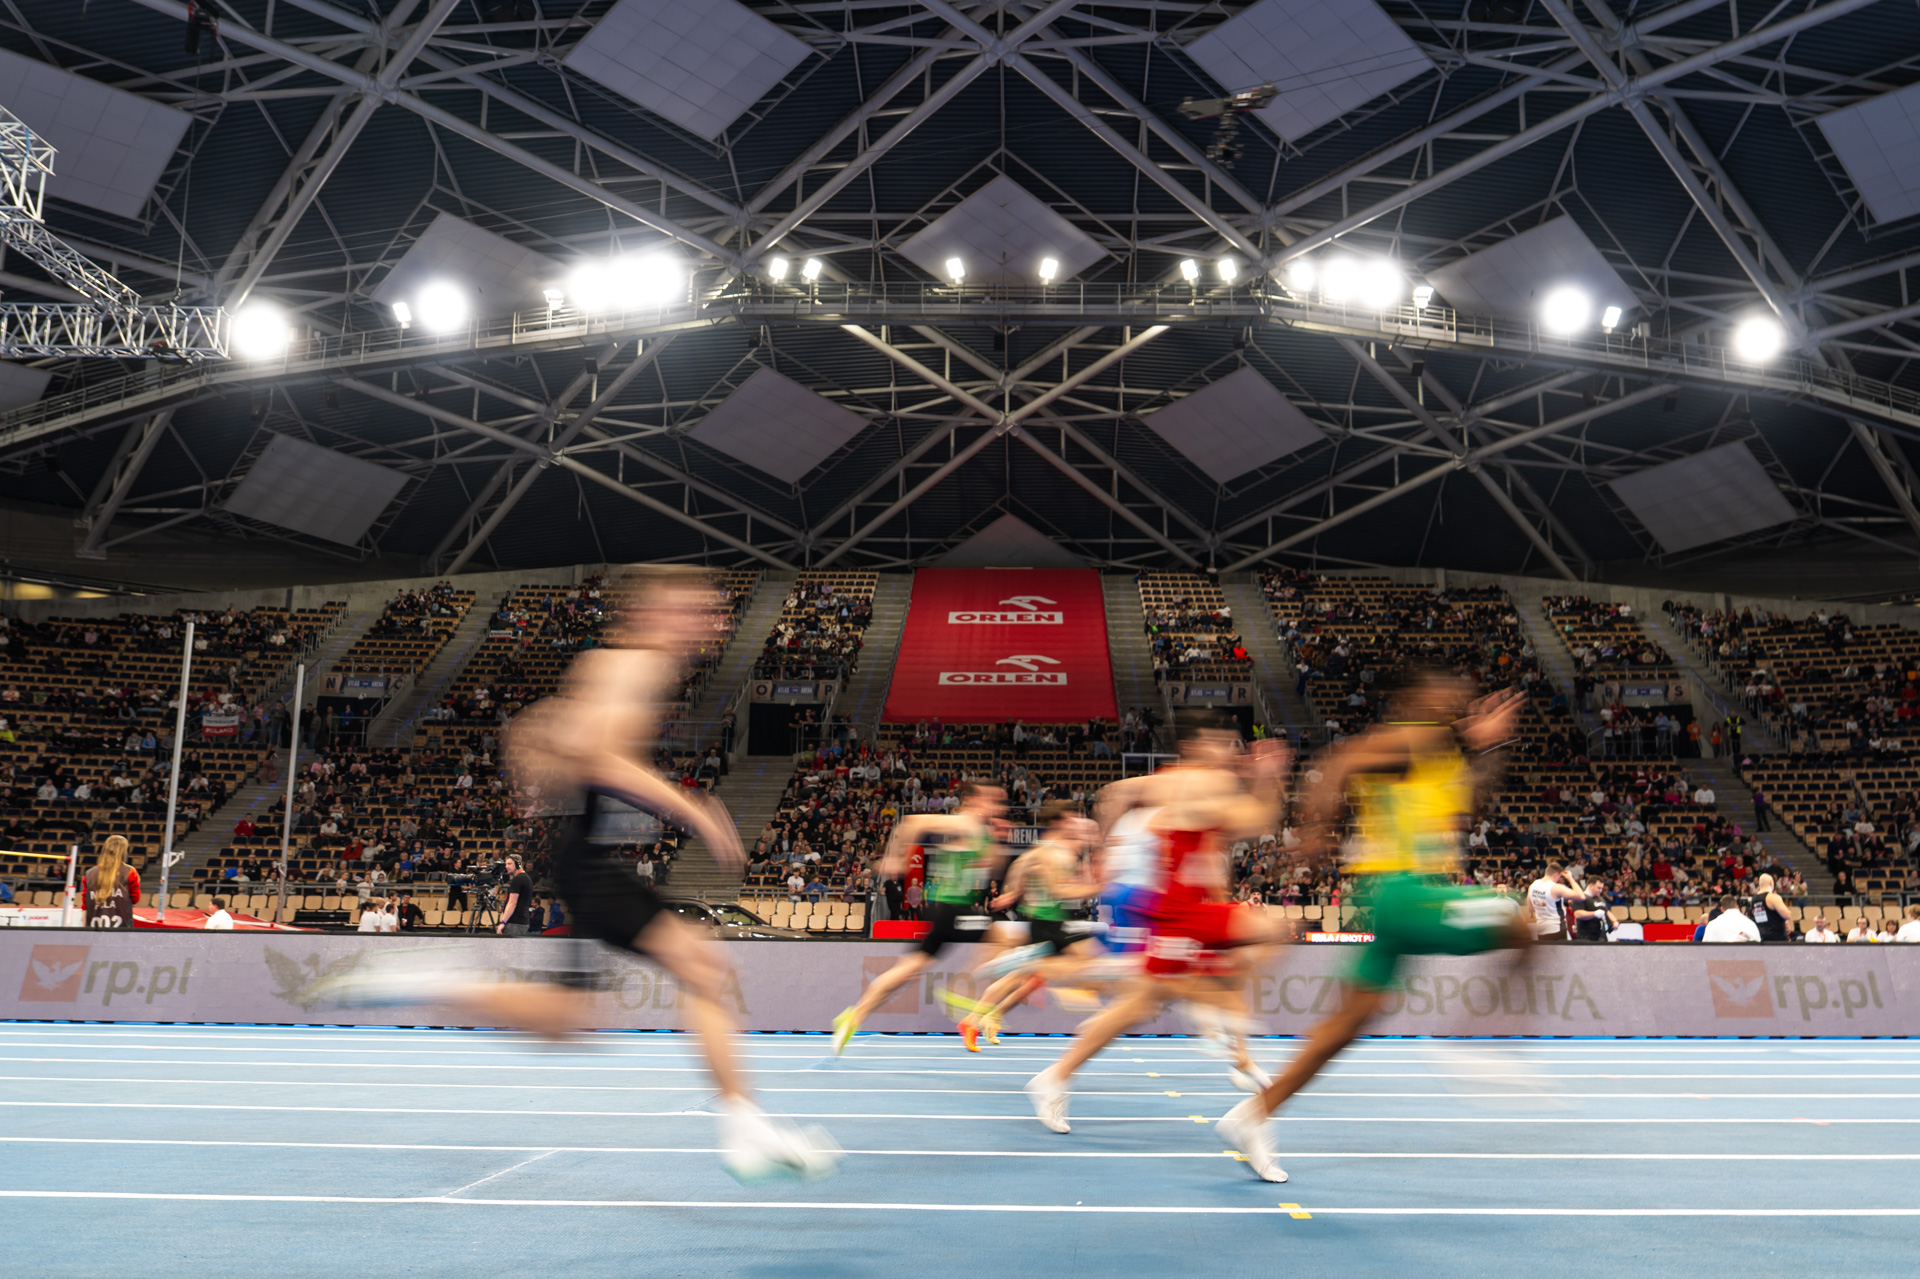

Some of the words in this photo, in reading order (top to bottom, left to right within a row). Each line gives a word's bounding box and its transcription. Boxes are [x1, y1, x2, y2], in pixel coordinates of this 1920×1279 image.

[955, 613, 1055, 622] ORLEN
[326, 677, 336, 689] N
[946, 673, 1059, 683] ORLEN
[756, 684, 768, 696] O
[824, 684, 833, 696] P
[1171, 687, 1179, 698] P
[1237, 687, 1247, 699] R
[1674, 684, 1683, 697] S
[1007, 828, 1039, 844] ARENA
[84, 957, 193, 1007] rp.pl
[1774, 970, 1884, 1022] rp.pl
